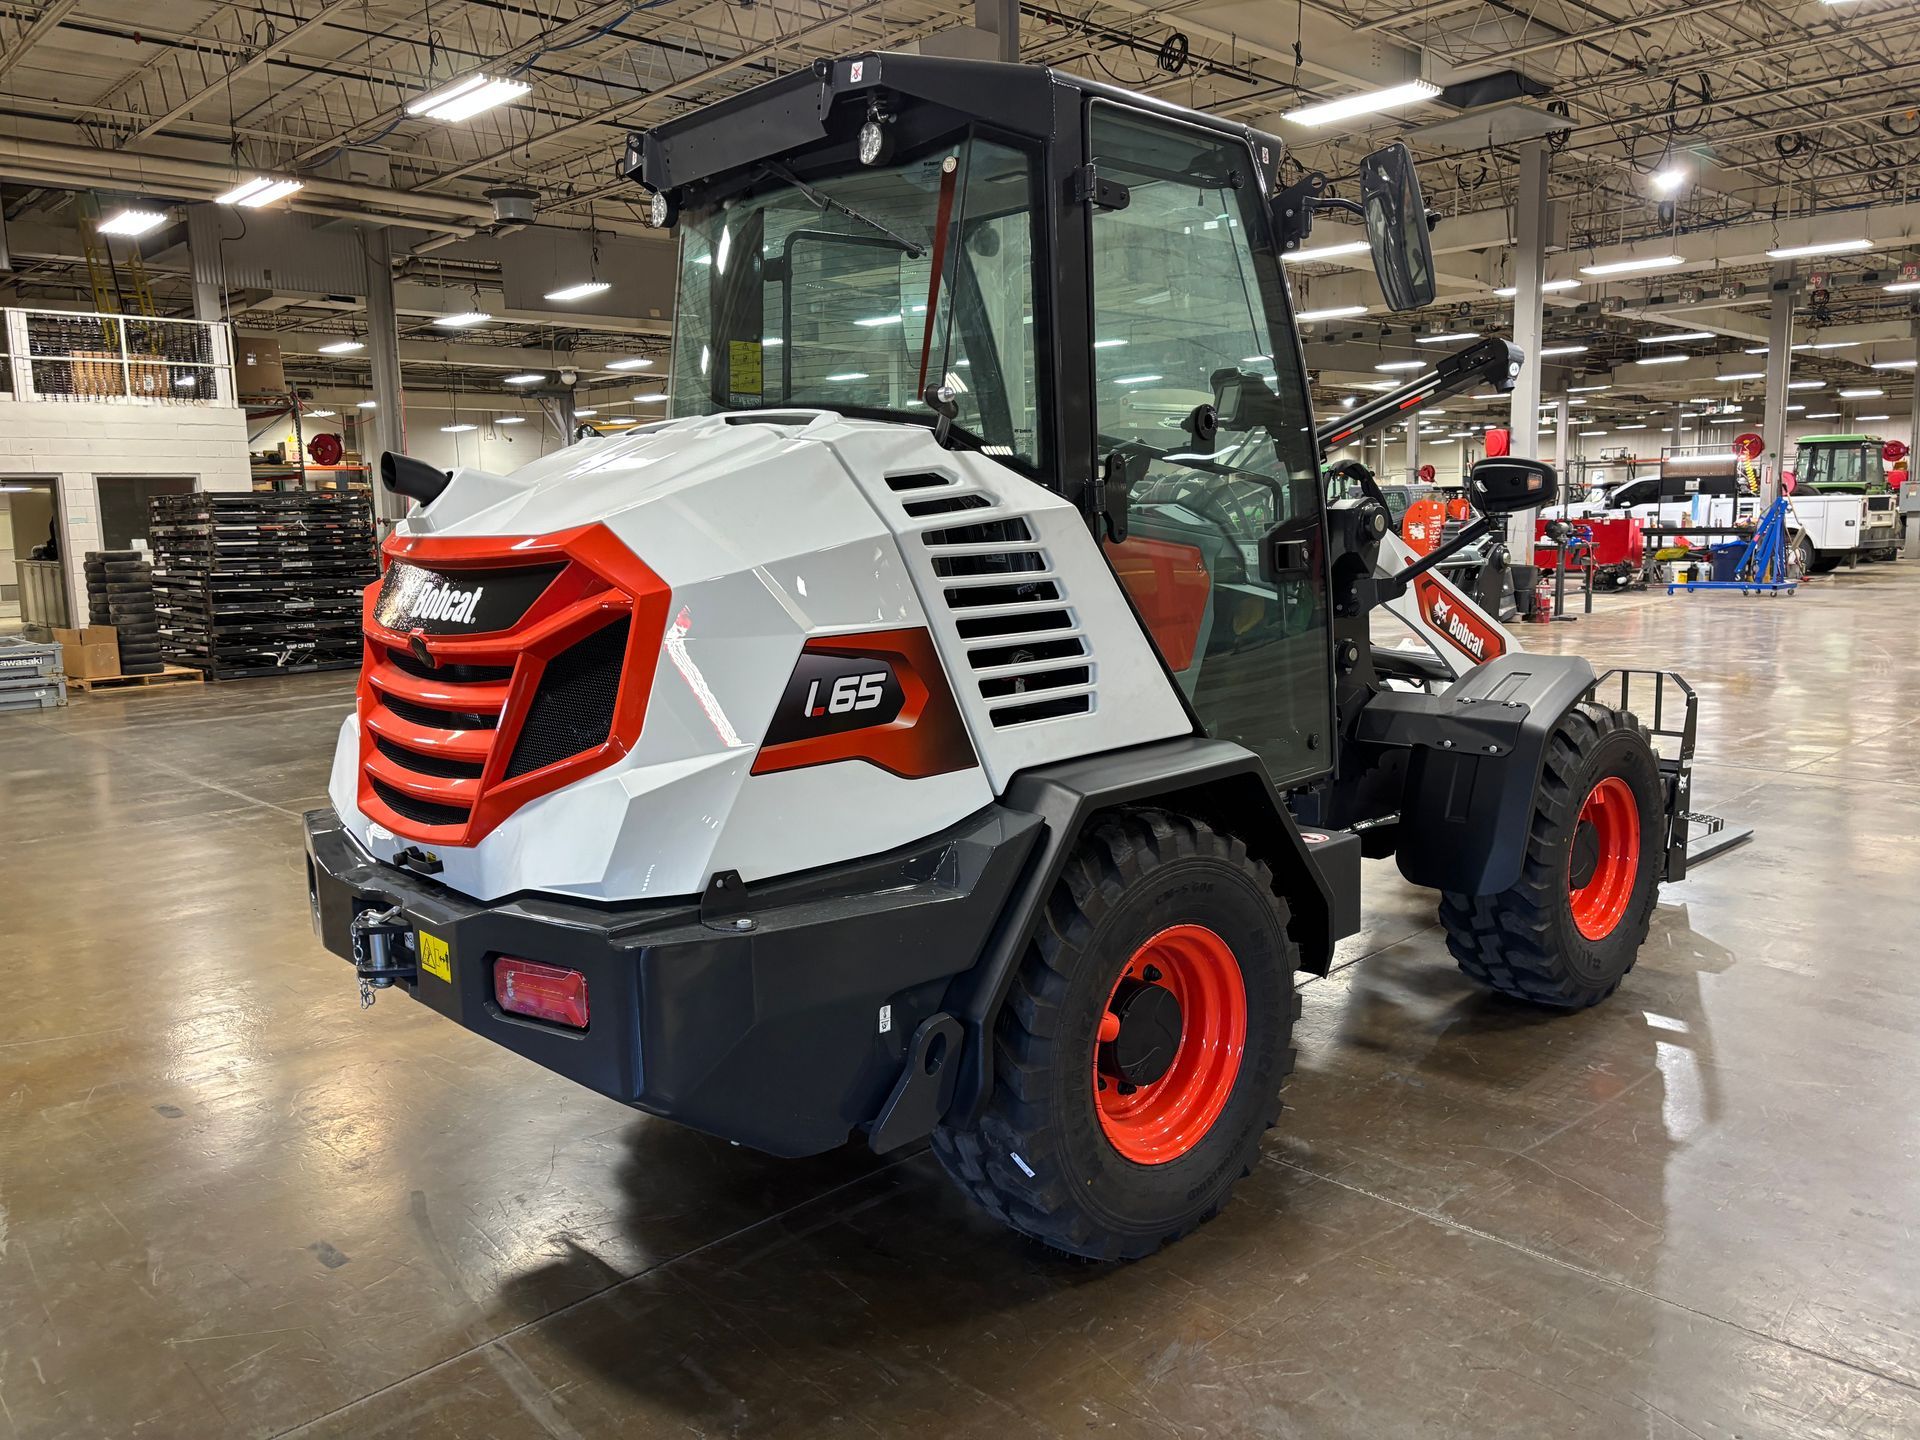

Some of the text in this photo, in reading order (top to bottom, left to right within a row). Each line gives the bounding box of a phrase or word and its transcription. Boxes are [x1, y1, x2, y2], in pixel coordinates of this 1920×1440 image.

[1810, 276, 1822, 285] 99
[1683, 291, 1693, 299] 93
[1724, 287, 1735, 296] 95
[410, 582, 484, 624] Bobcat
[1448, 613, 1484, 659] Bobcat
[0, 656, 43, 667] awasaki
